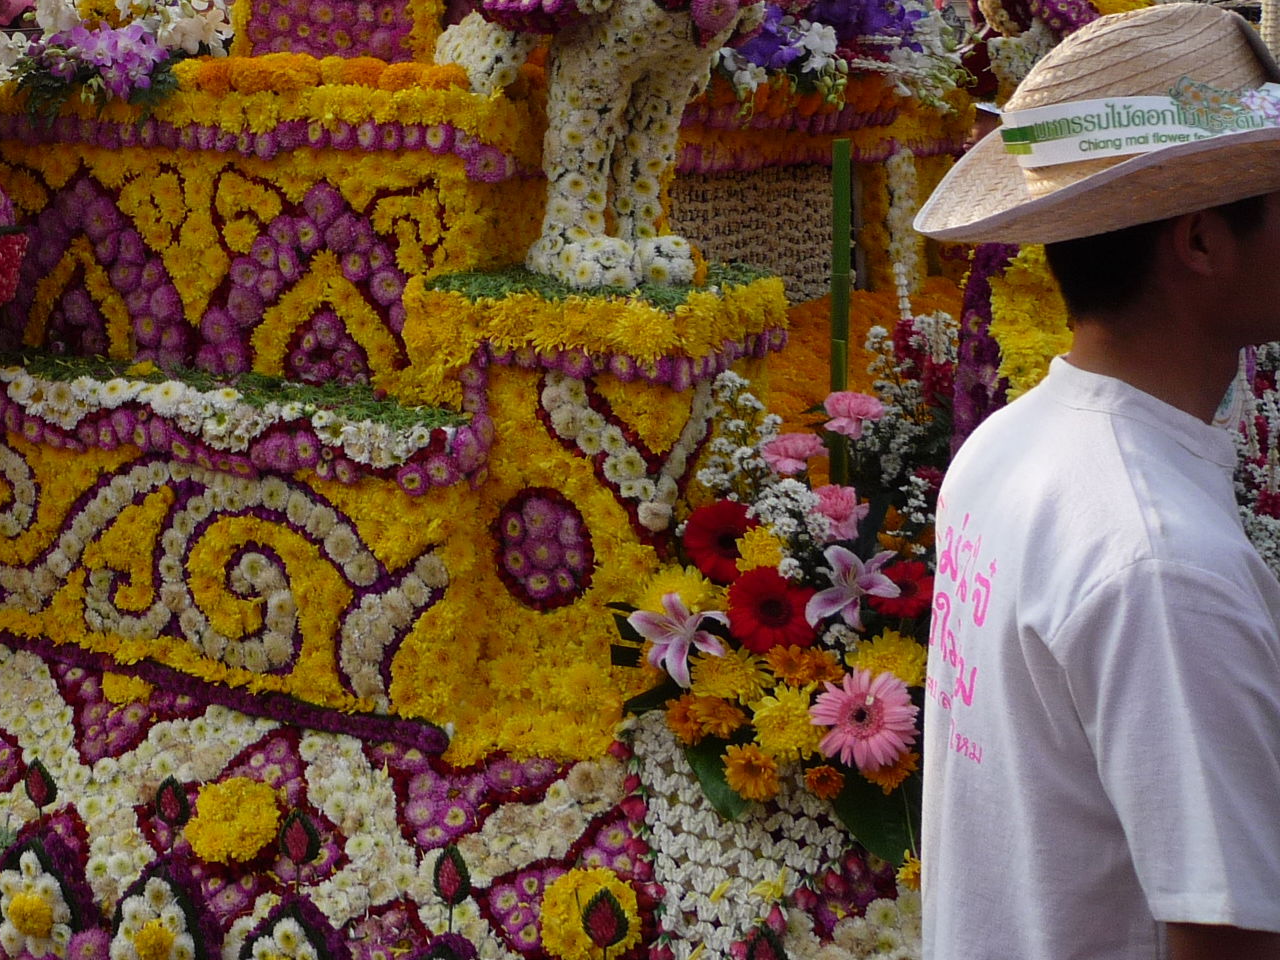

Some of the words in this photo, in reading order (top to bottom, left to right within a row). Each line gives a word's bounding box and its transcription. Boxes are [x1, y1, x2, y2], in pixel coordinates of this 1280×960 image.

[1079, 137, 1122, 151] Chiang
[1125, 133, 1149, 146] mai
[1152, 132, 1190, 144] flower
